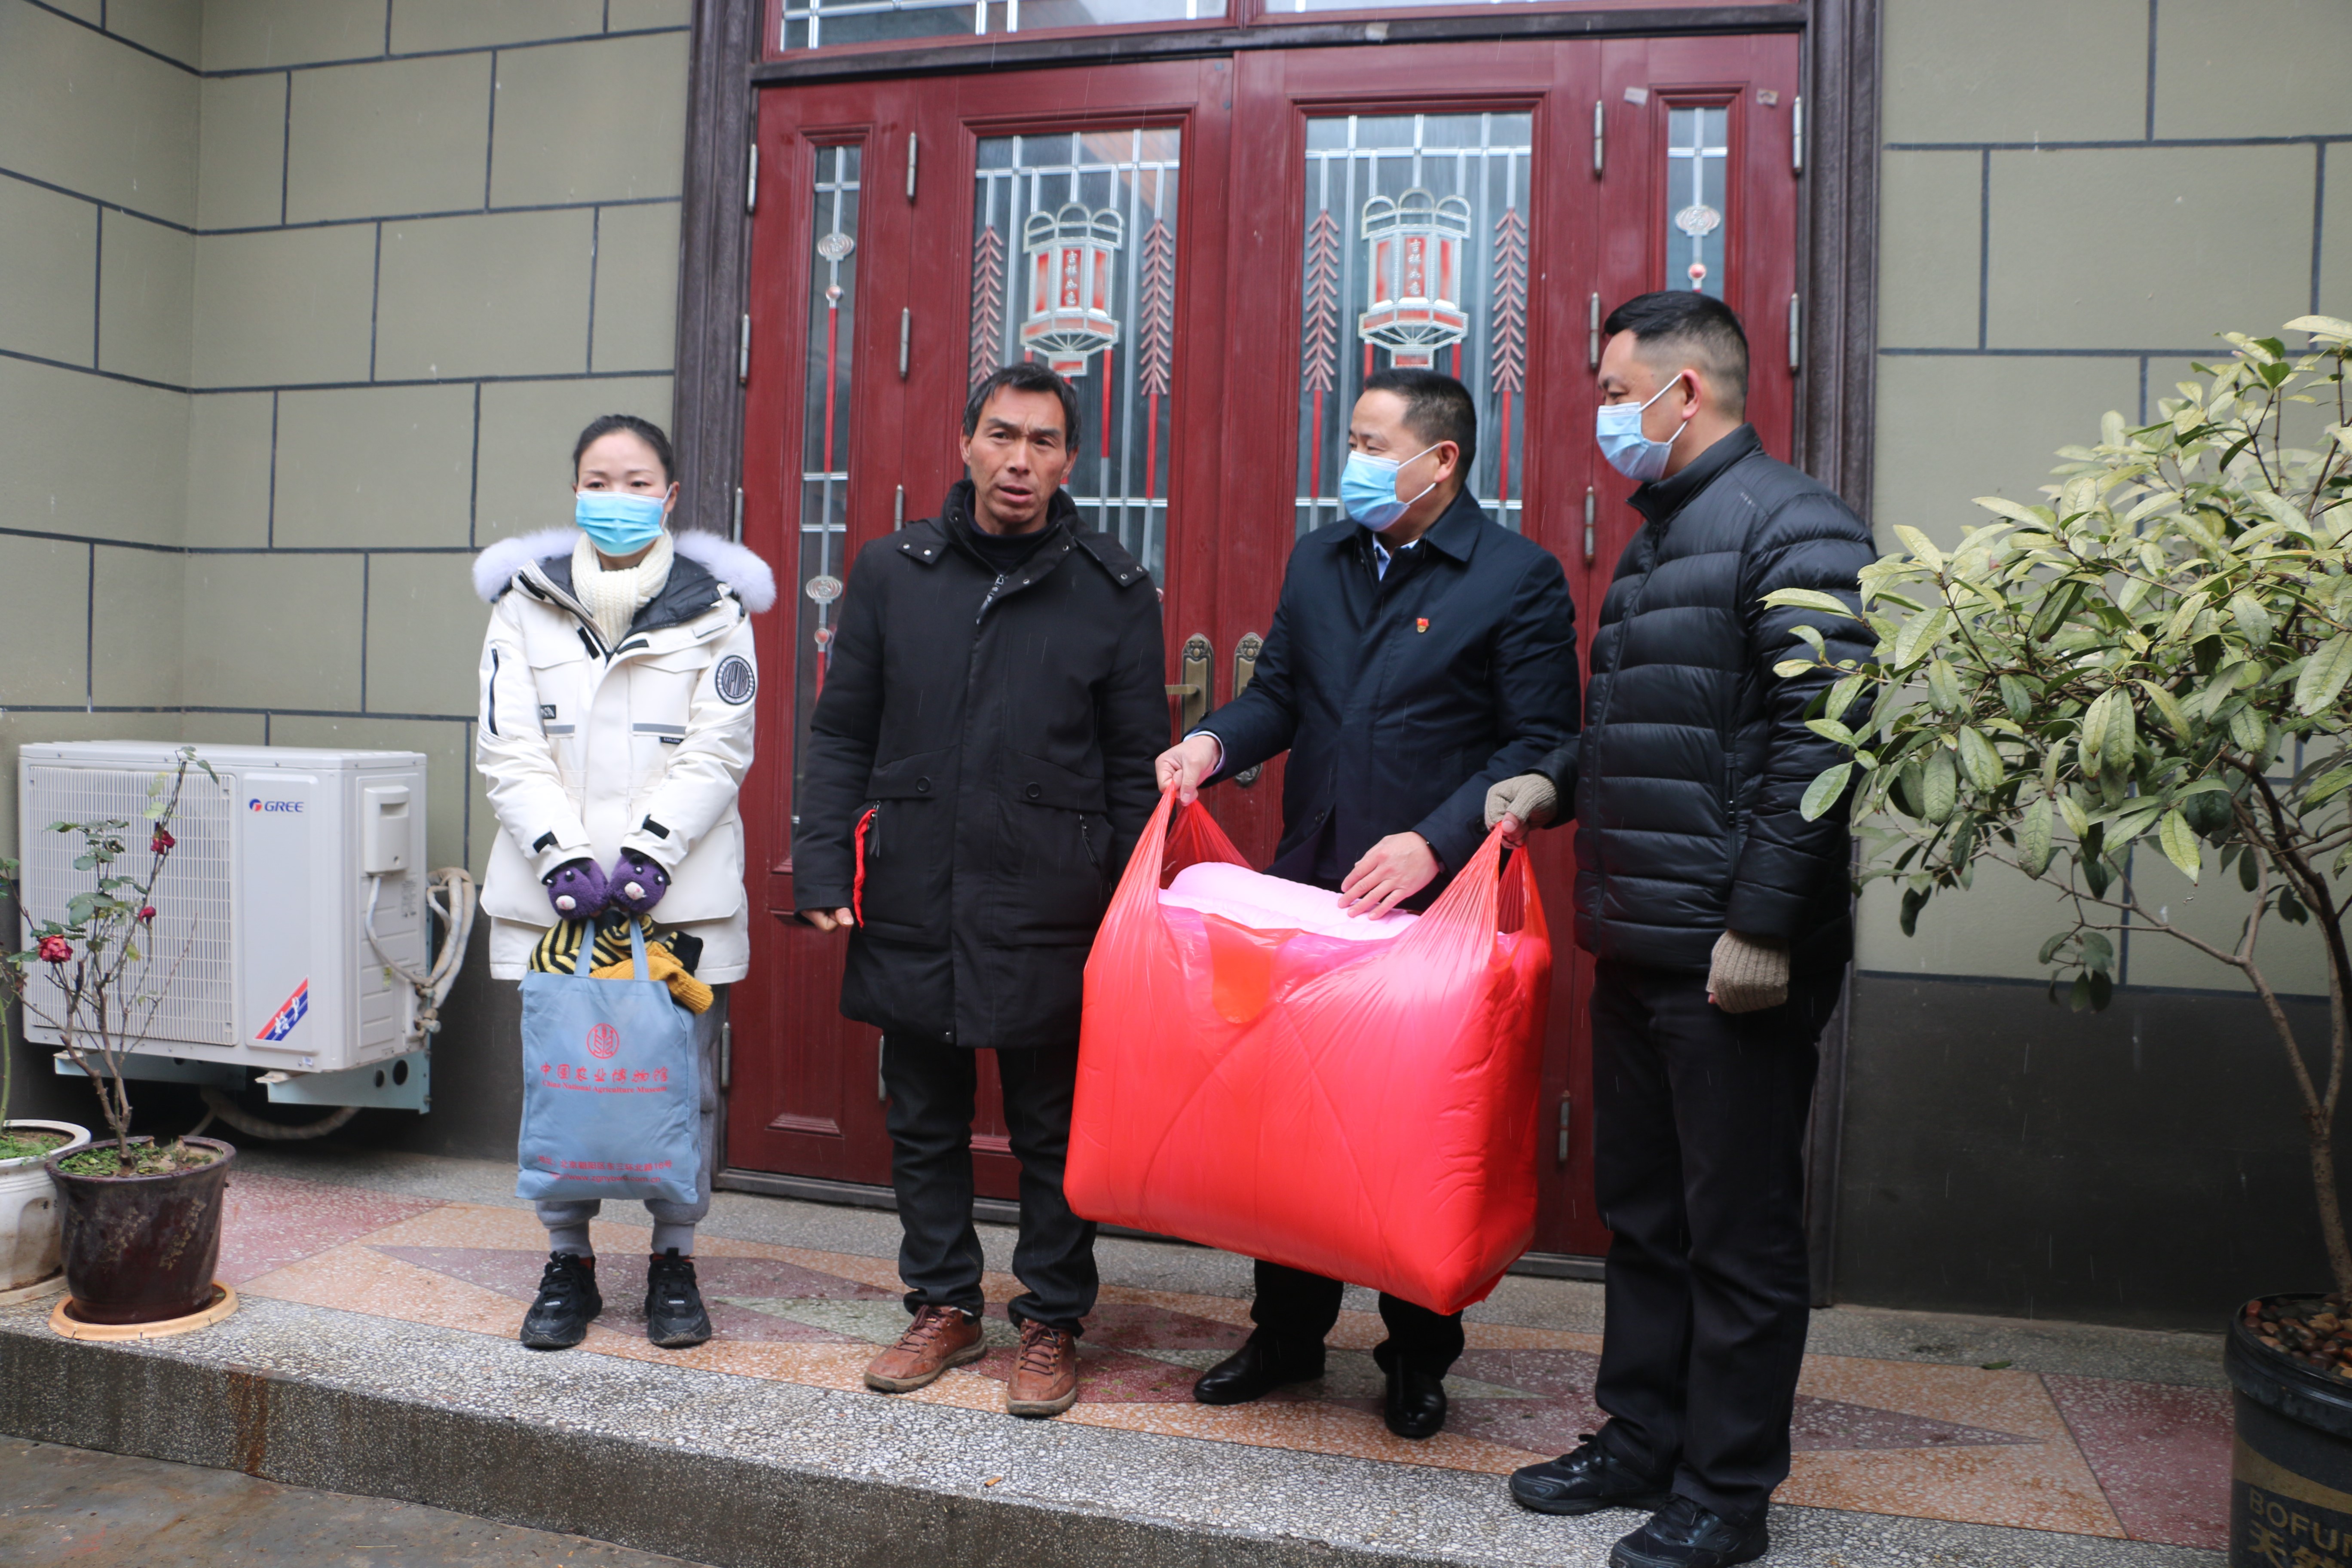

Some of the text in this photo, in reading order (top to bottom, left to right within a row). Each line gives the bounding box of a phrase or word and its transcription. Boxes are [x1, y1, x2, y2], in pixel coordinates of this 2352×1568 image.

[264, 801, 304, 812] GREE
[540, 1062, 668, 1084] 中国农业博物馆
[542, 1080, 560, 1088] China
[562, 1082, 591, 1092] National
